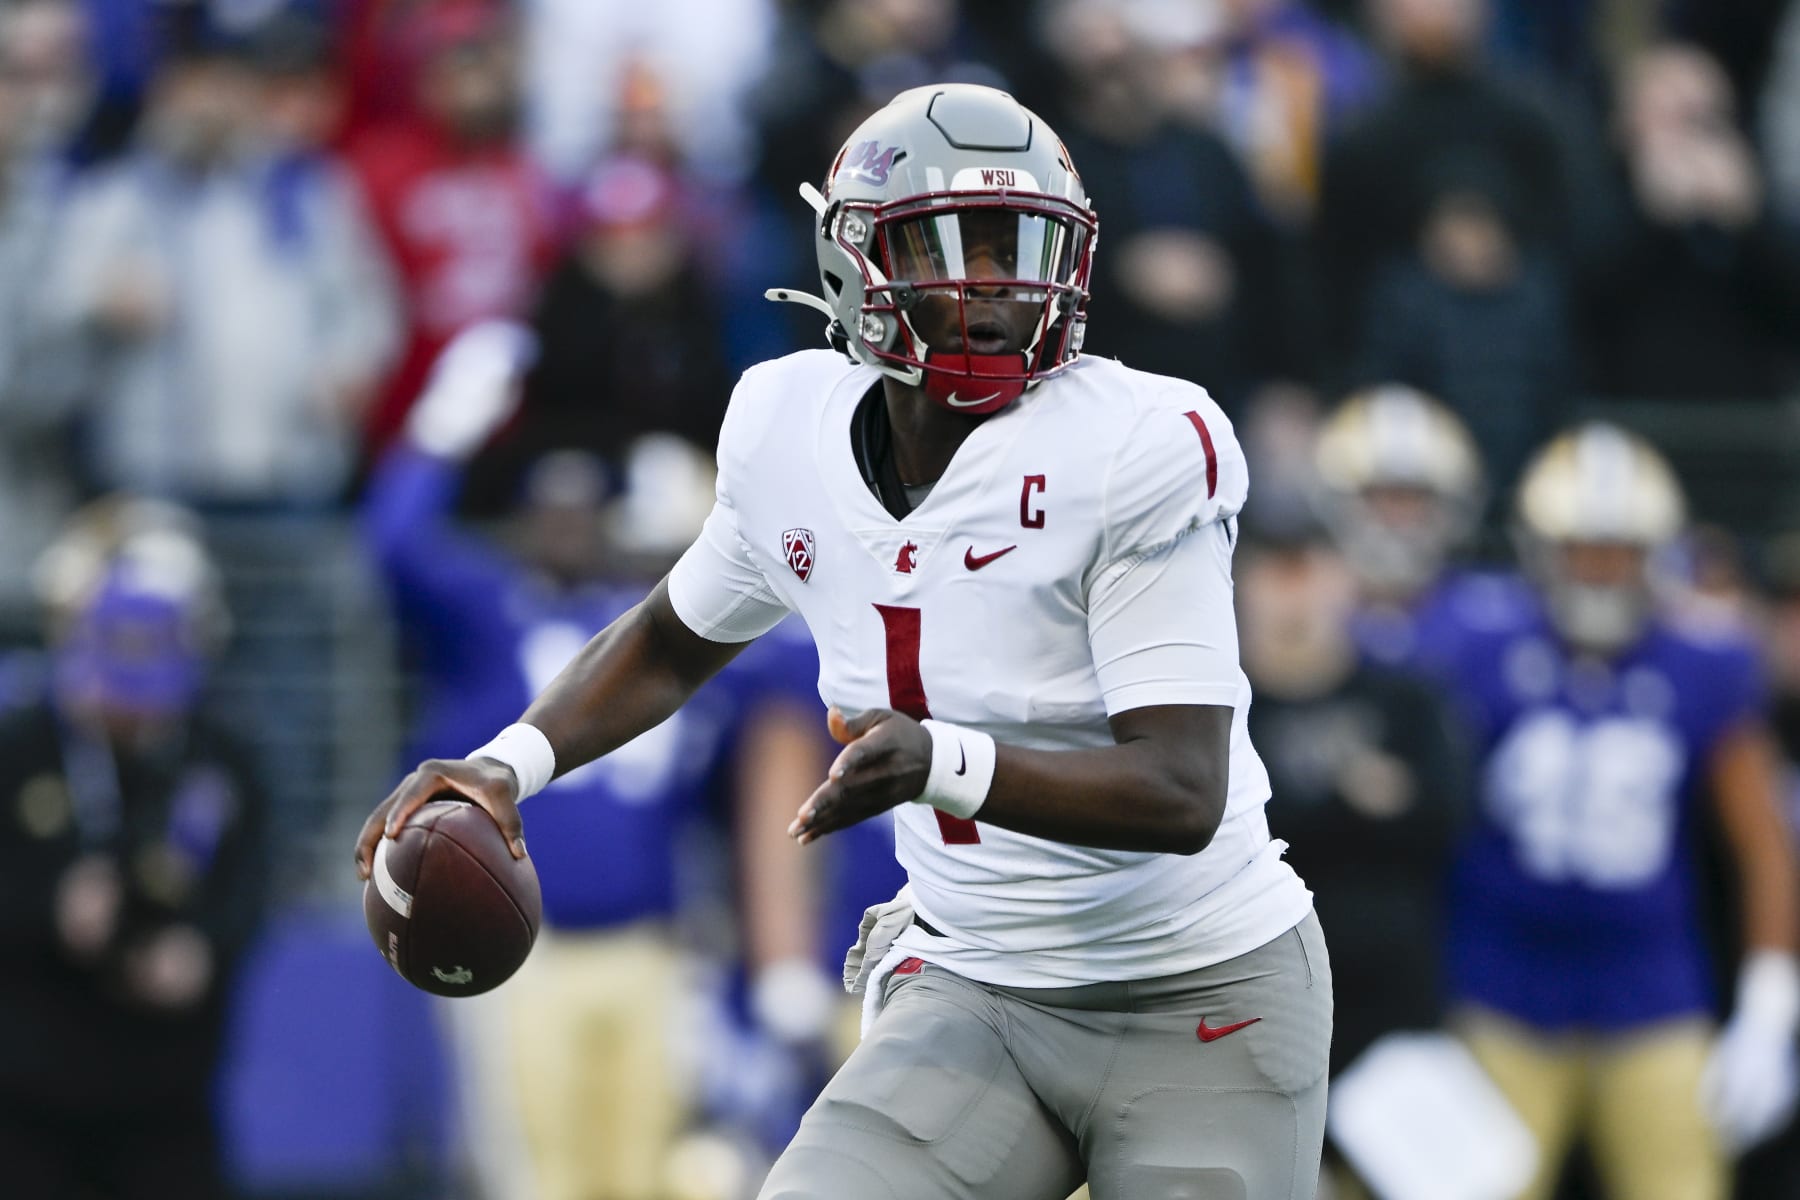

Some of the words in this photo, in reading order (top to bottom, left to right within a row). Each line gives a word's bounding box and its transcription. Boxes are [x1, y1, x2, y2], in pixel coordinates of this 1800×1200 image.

[981, 169, 1015, 187] WSU
[1181, 410, 1217, 500] 1
[1020, 474, 1046, 530] C
[783, 529, 815, 561] PAC
[792, 550, 809, 571] 12
[871, 602, 981, 845] 1
